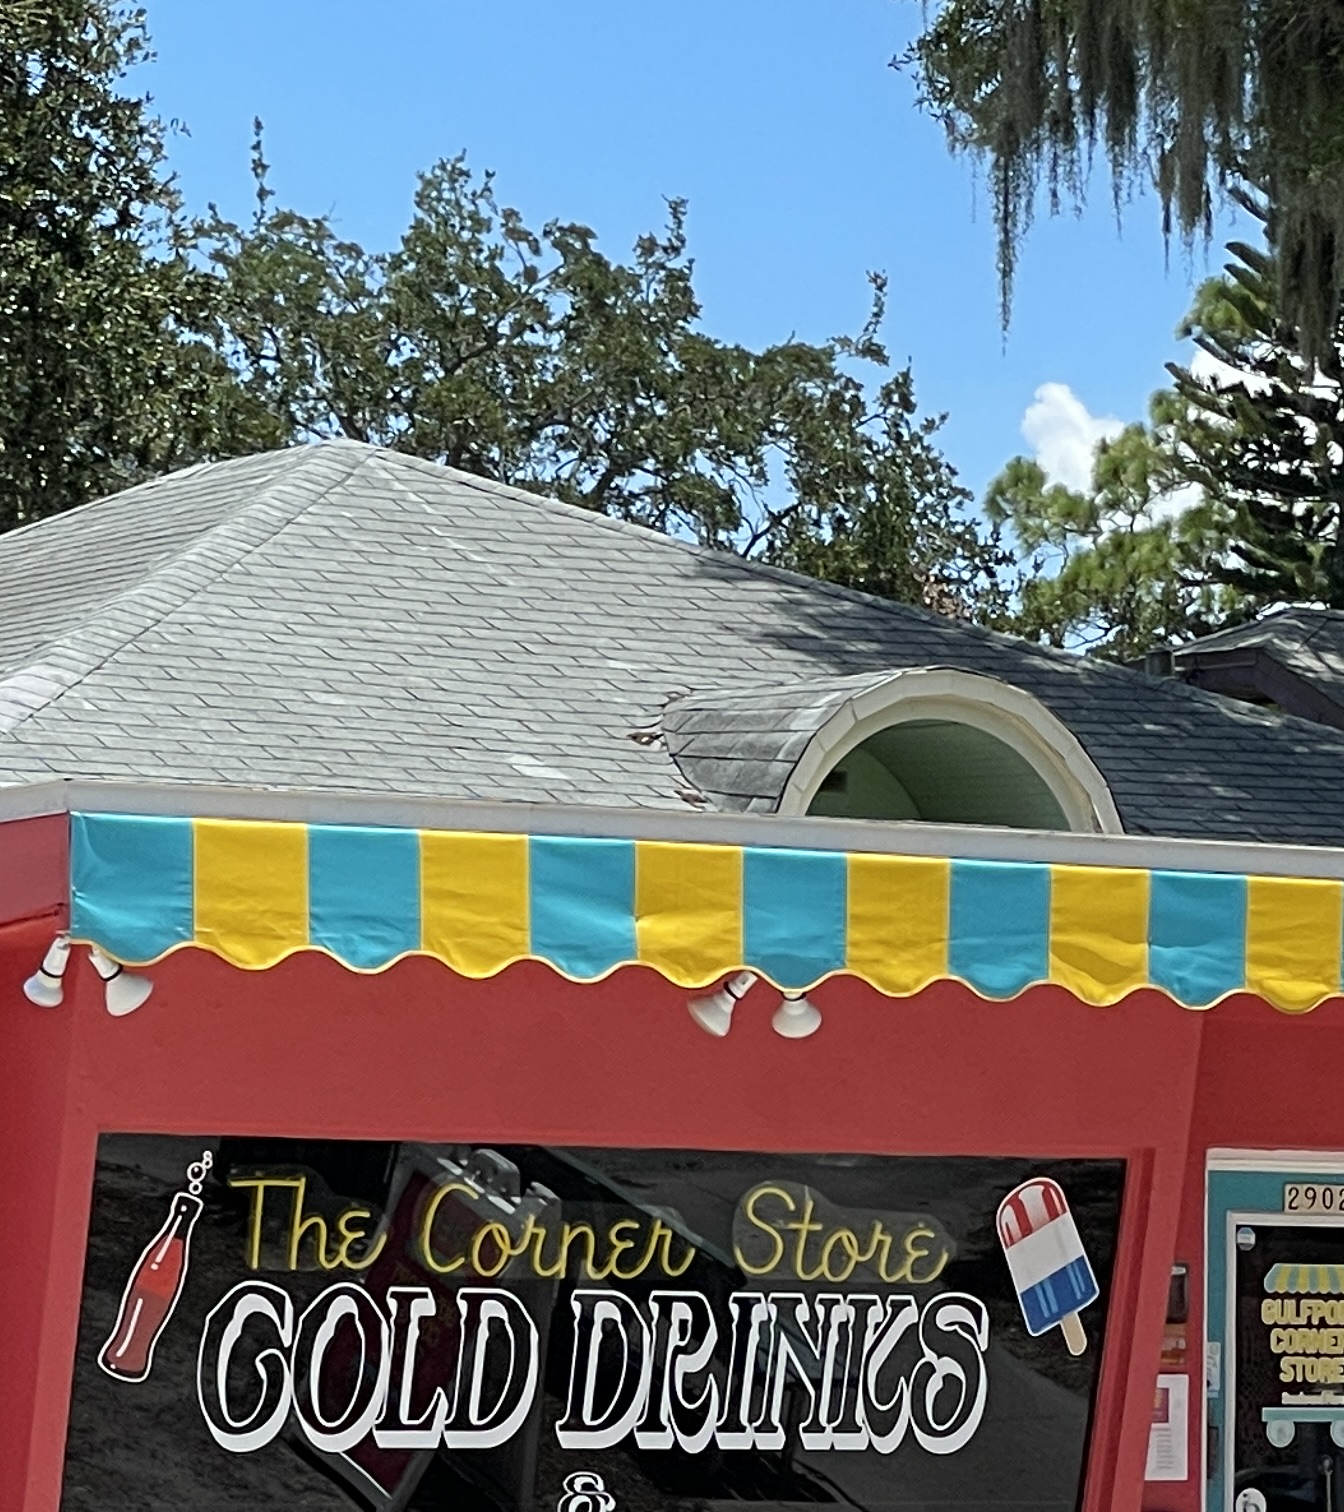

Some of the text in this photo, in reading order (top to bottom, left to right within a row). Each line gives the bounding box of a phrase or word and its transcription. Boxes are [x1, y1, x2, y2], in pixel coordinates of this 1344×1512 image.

[228, 1176, 957, 1284] The Corner Store
[197, 1280, 991, 1454] COLD DRINKS
